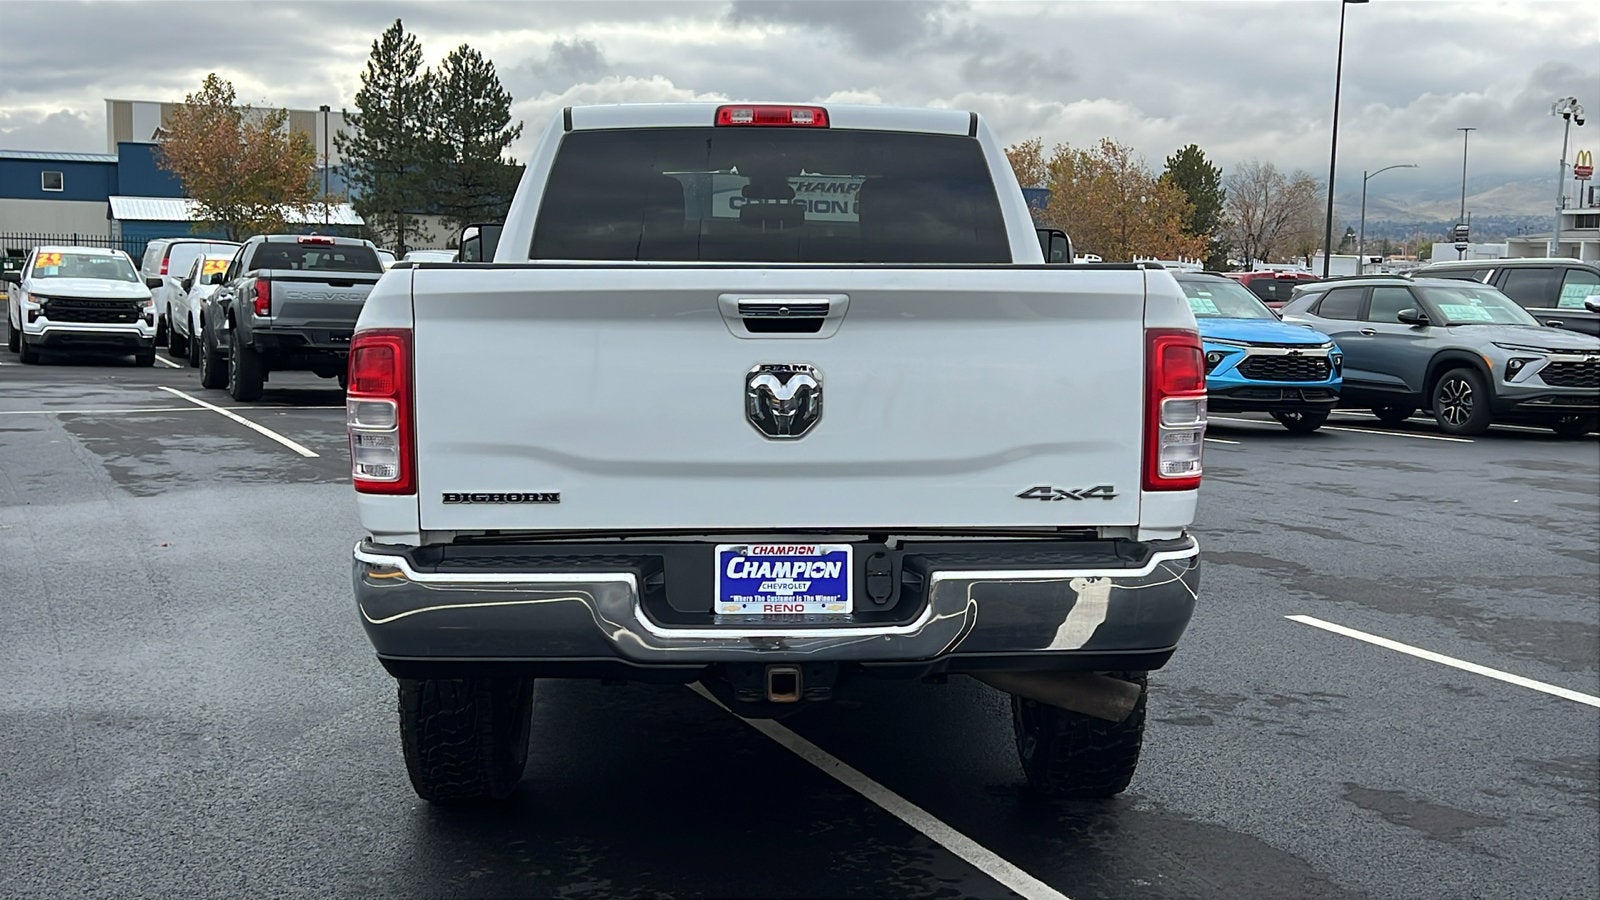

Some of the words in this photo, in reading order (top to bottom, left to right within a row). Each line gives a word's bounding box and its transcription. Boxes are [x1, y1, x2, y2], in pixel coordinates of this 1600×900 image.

[752, 546, 815, 555] CHAMPION
[726, 556, 842, 579] CHAMPION
[763, 604, 805, 613] RENO
